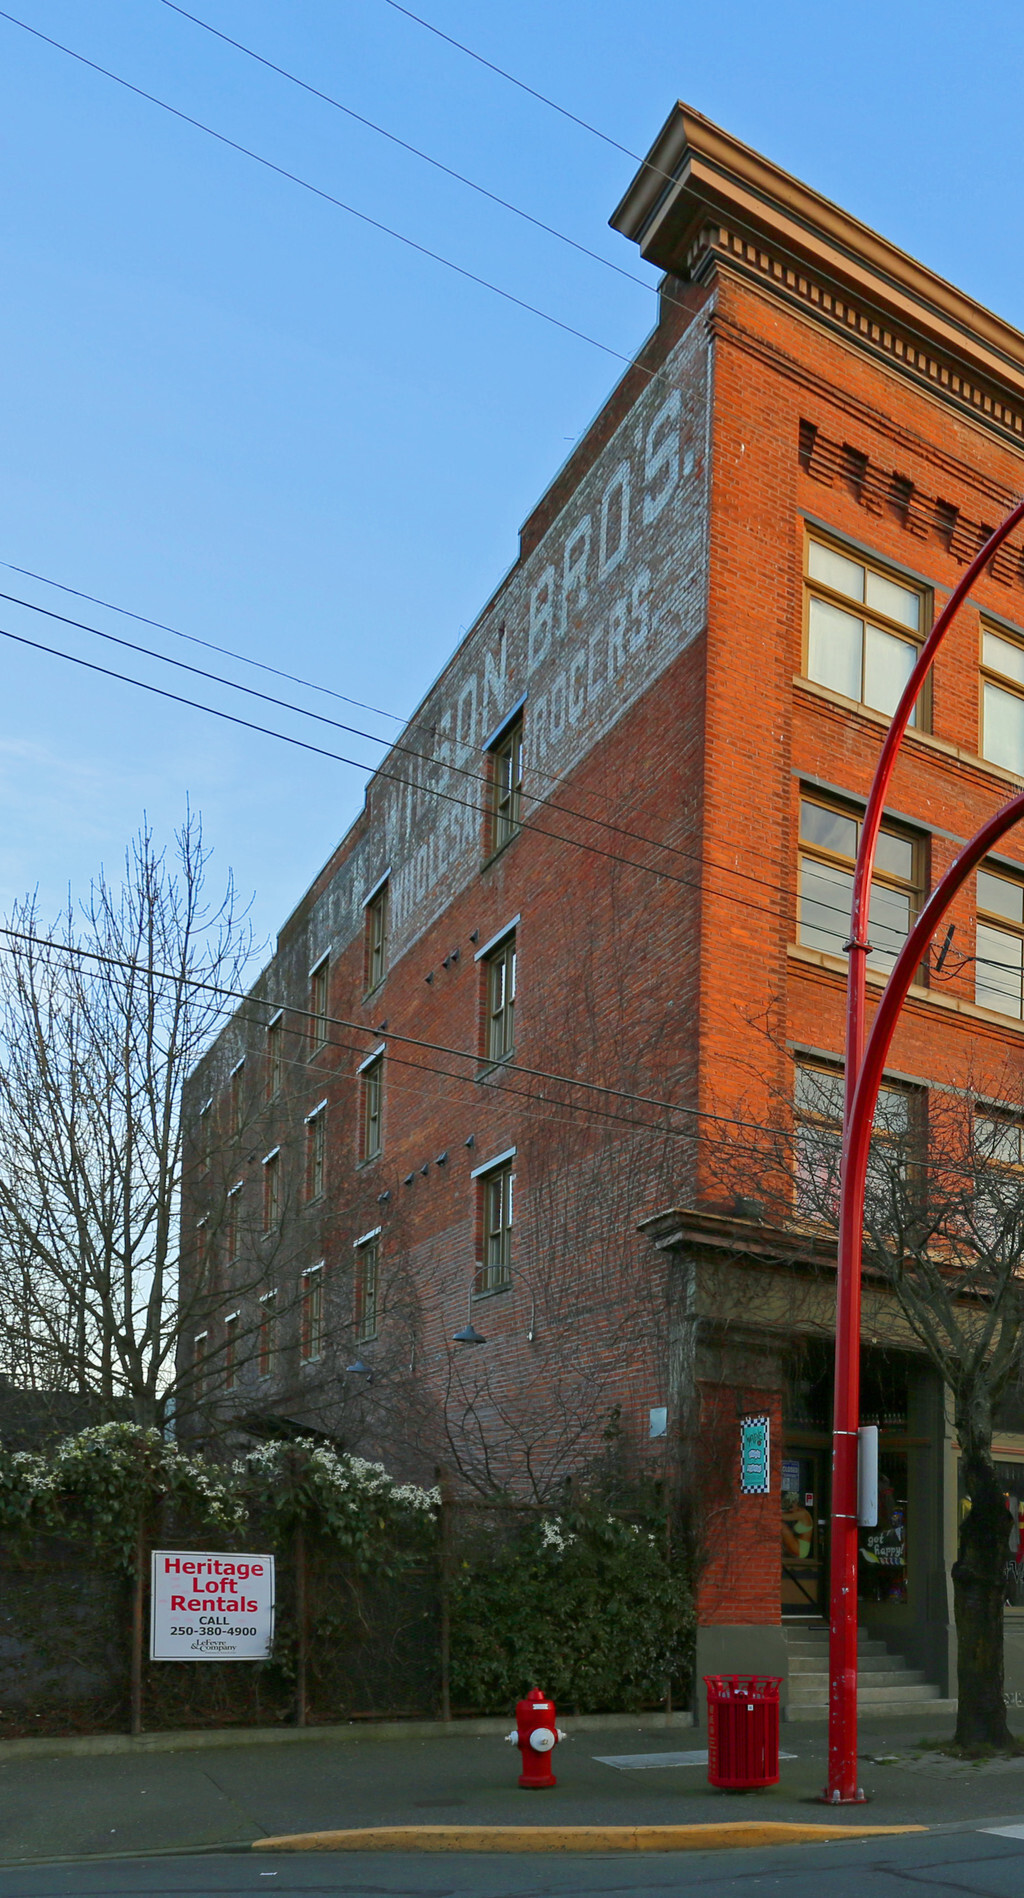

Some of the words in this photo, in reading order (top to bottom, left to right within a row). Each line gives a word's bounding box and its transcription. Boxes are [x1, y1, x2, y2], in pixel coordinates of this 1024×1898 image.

[867, 1532, 884, 1547] got
[164, 1557, 264, 1580] Heritage
[192, 1577, 238, 1594] Loft
[170, 1595, 258, 1612] Rentals
[199, 1616, 230, 1625] CALL
[170, 1626, 257, 1636] 250-380-4900
[199, 1643, 237, 1652] Company
